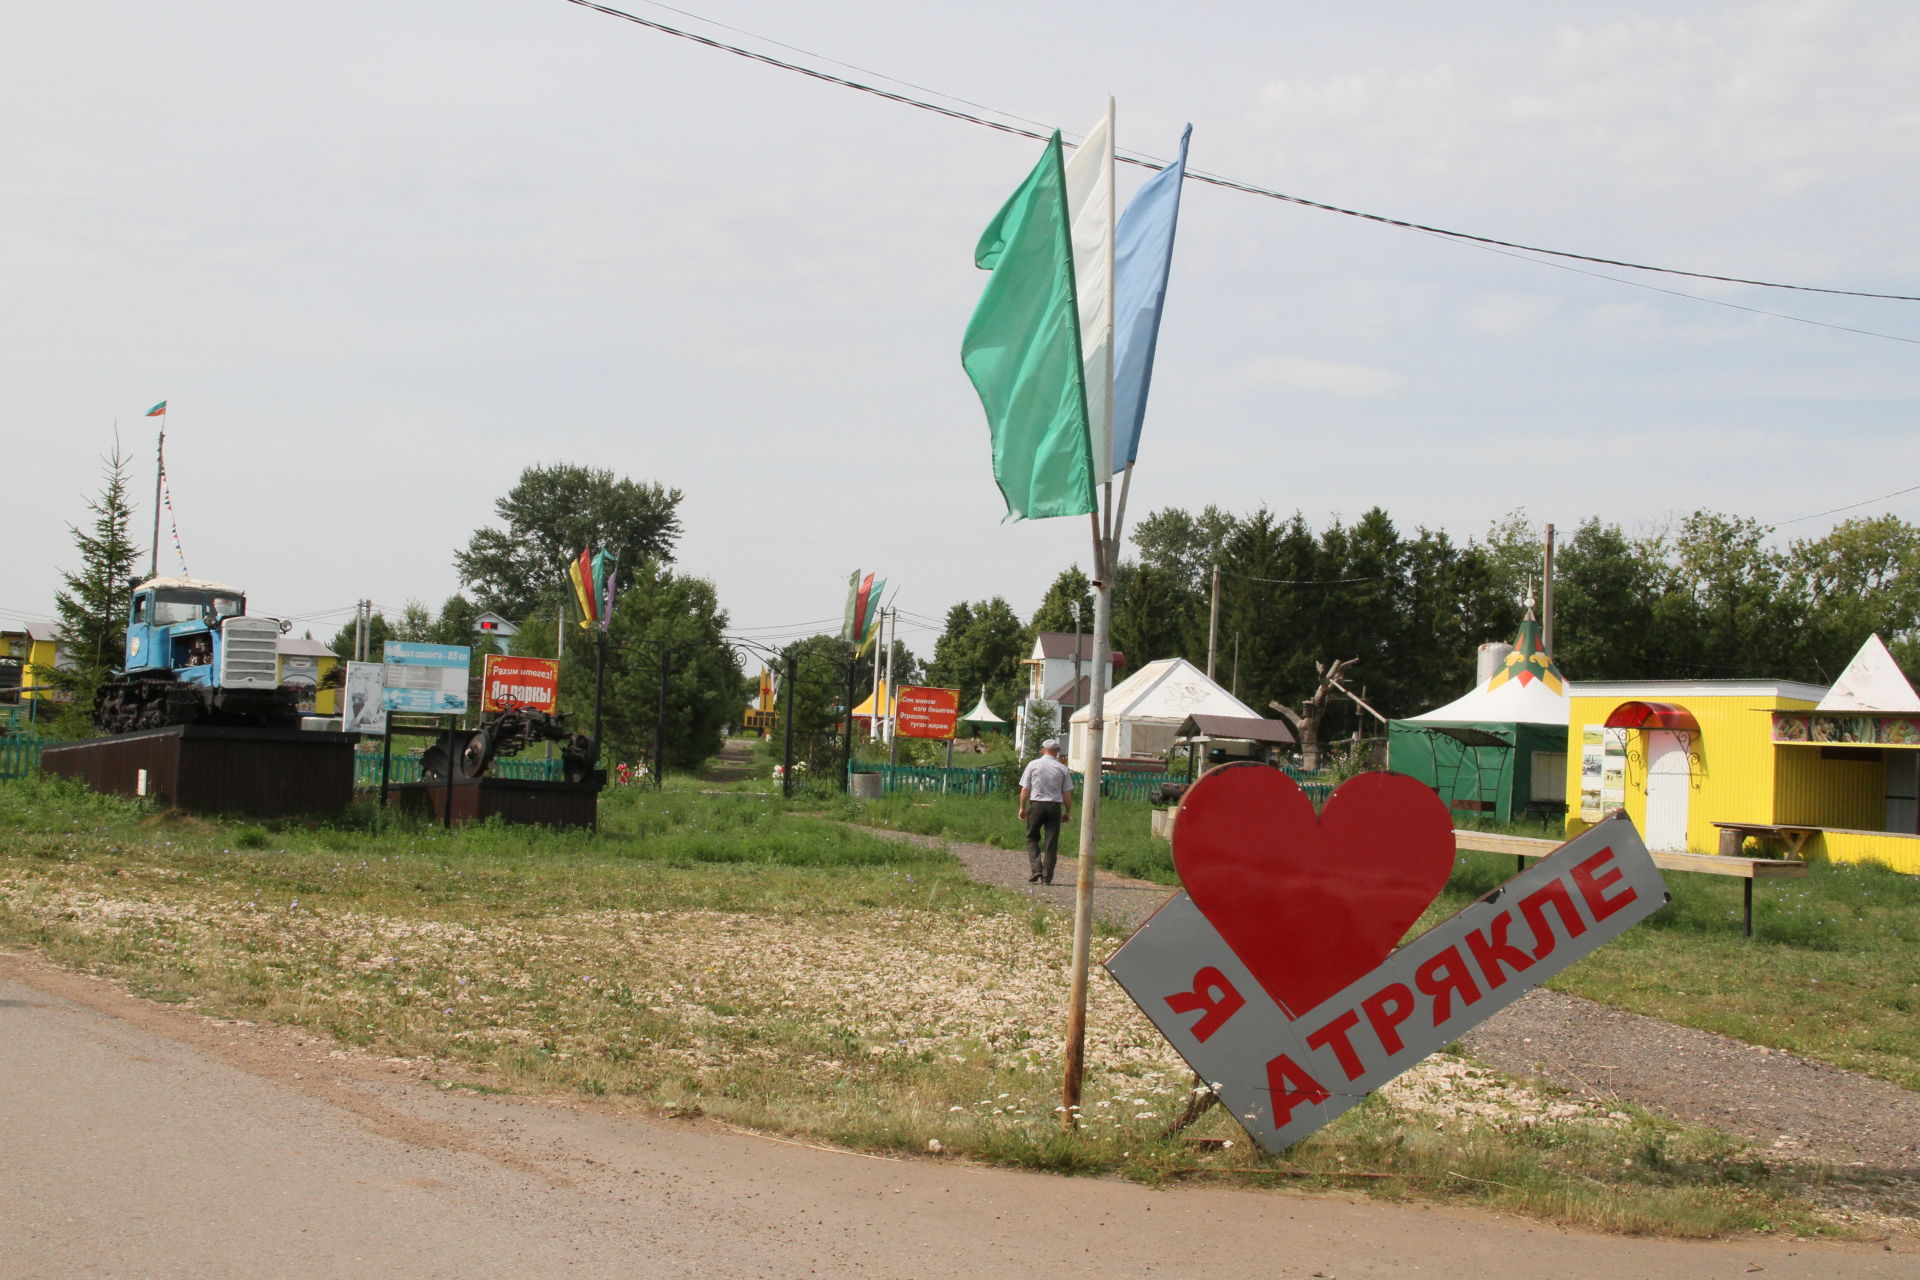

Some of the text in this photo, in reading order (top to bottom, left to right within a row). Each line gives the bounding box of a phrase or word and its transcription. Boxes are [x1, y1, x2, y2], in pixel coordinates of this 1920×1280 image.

[520, 669, 553, 680] итегез!
[1163, 965, 1246, 1044] Я
[1265, 846, 1638, 1130] АТРЯКЛЕ
